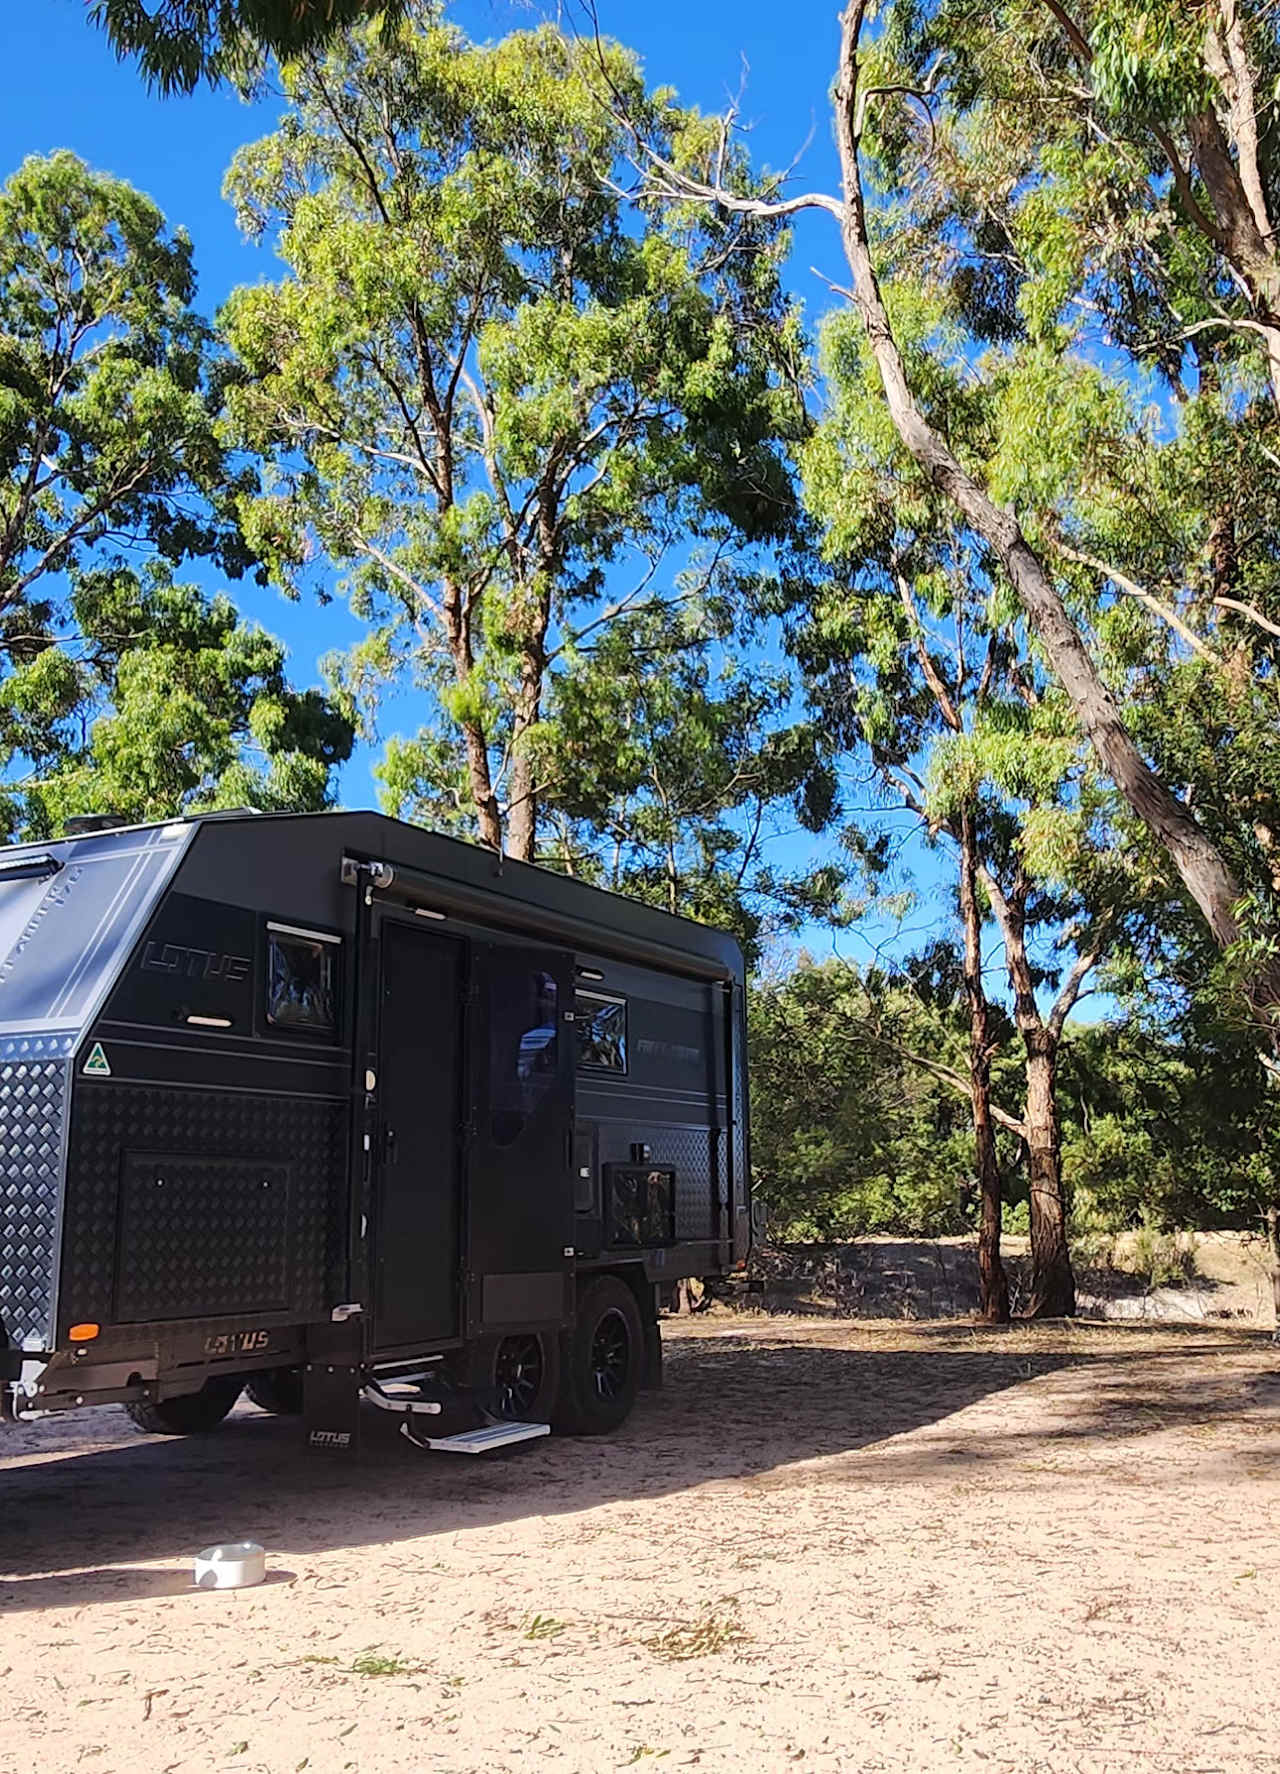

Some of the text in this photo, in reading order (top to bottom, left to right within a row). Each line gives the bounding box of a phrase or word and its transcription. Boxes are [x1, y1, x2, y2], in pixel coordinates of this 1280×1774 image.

[140, 941, 251, 981] LOTUS
[203, 1331, 269, 1354] LOTUS
[311, 1430, 351, 1444] LOTUS
